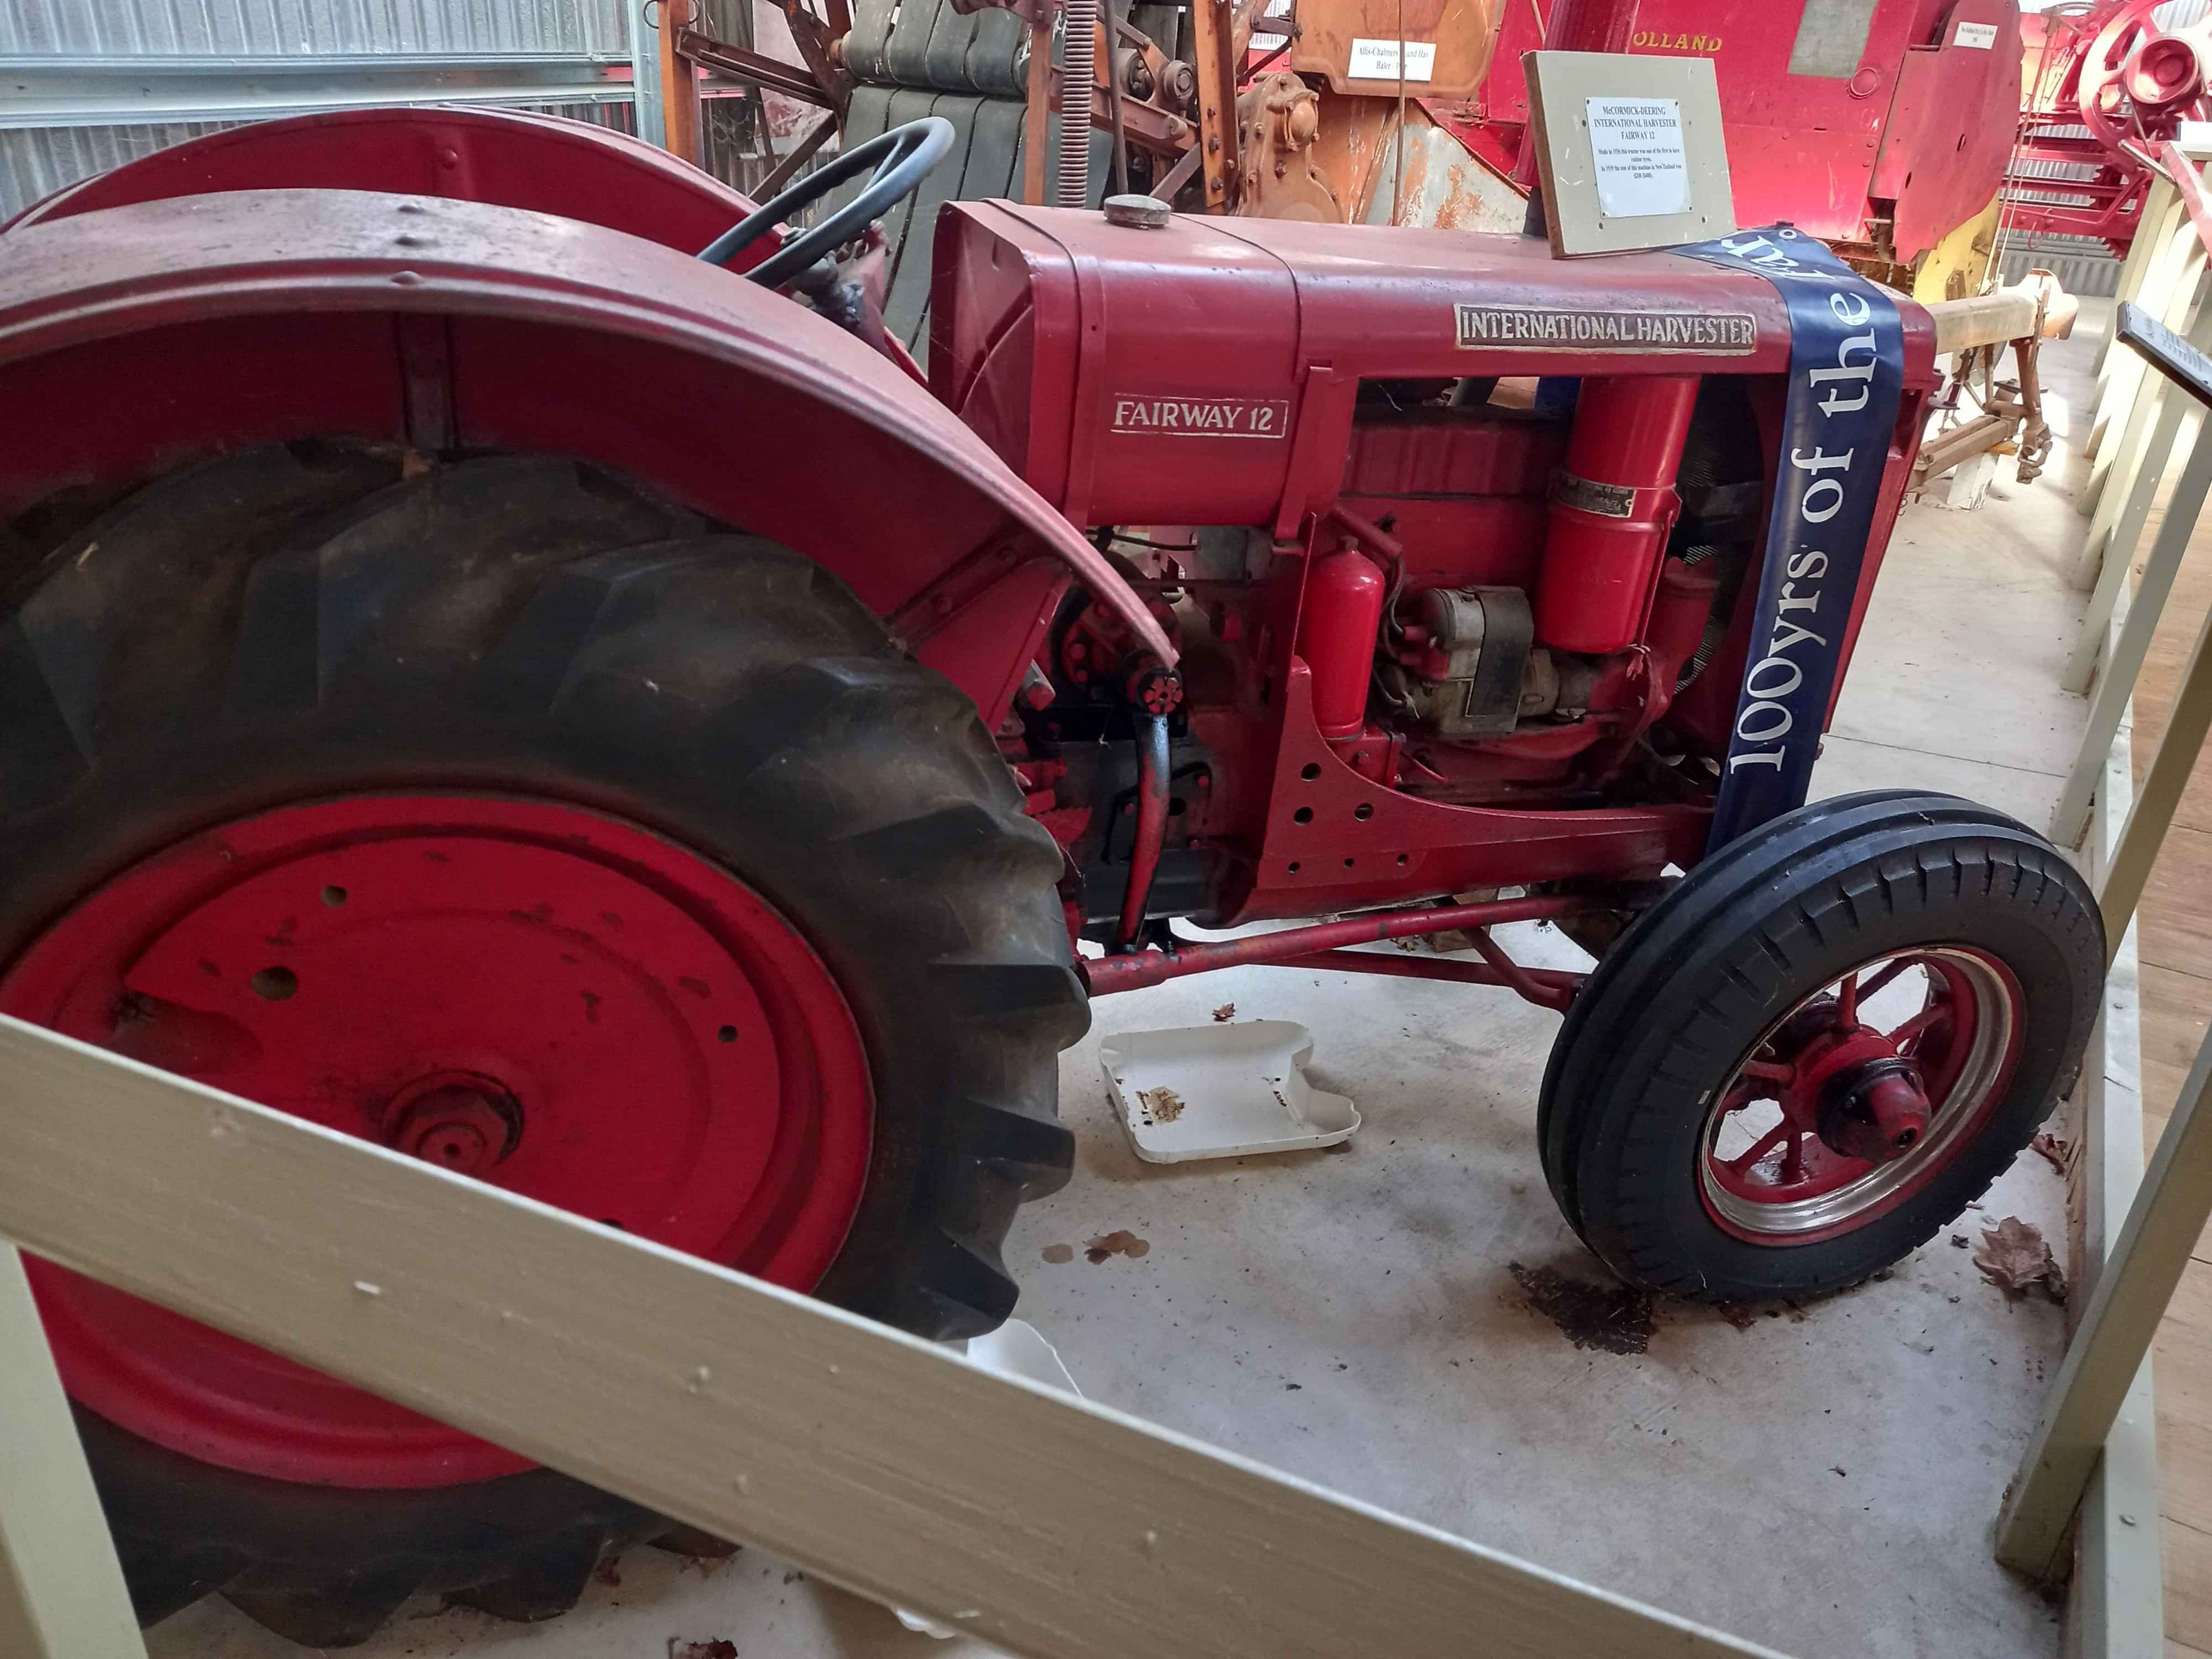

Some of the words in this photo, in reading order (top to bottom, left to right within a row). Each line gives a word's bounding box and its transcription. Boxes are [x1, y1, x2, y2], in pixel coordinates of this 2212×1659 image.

[1632, 30, 1723, 52] OLLAND
[1359, 46, 1399, 57] Allis-Chalmers
[1376, 60, 1391, 70] Baler
[1602, 106, 1666, 116] McCORMICK-DEERING
[1594, 119, 1642, 128] INTERNATIONAL
[1644, 119, 1677, 128] HARVESTER
[1621, 131, 1648, 139] FAIRWAY
[1649, 131, 1655, 139] 12
[1462, 311, 1635, 342] INTERNATIONAL
[1637, 316, 1755, 345] HARVESTER
[1809, 291, 1877, 418] the
[1114, 400, 1243, 429] FAIRWAY
[1249, 406, 1274, 431] 12
[1791, 446, 1854, 524] of
